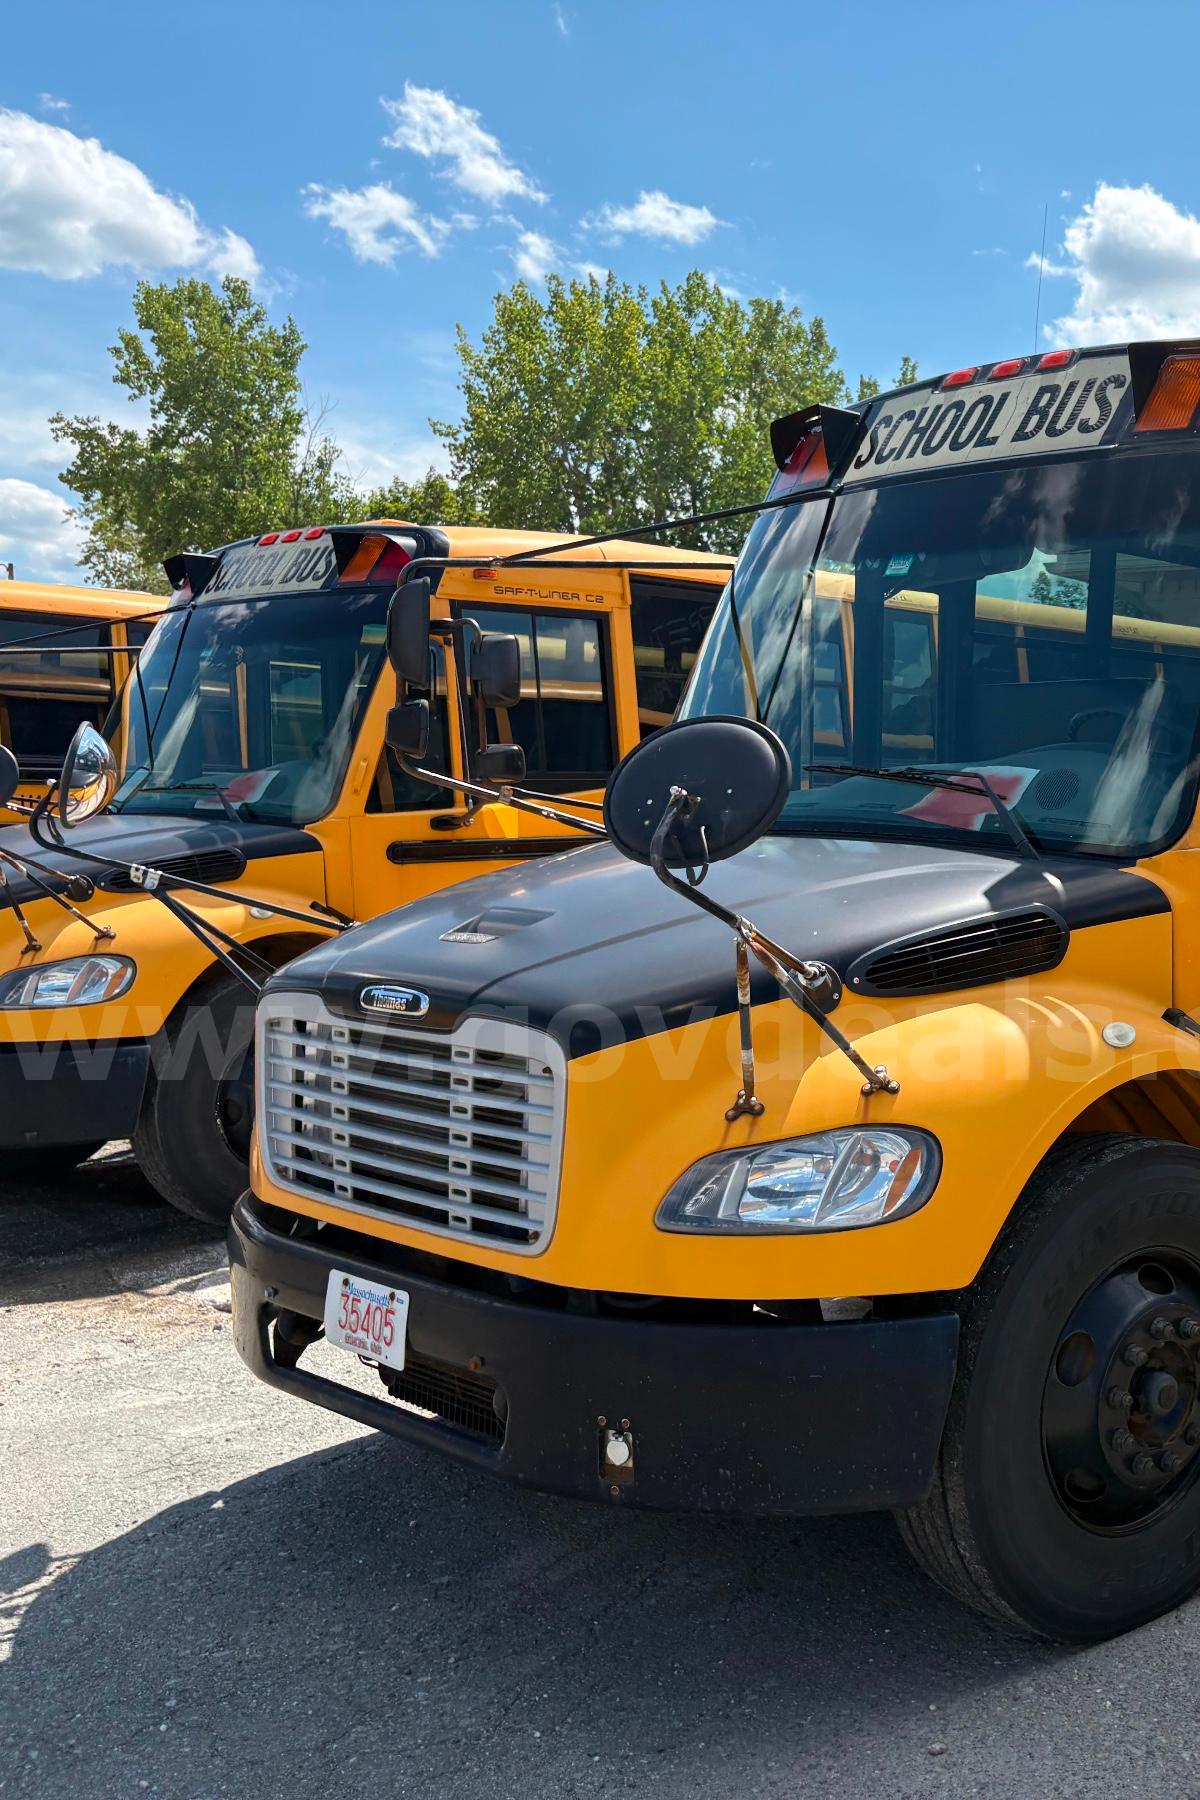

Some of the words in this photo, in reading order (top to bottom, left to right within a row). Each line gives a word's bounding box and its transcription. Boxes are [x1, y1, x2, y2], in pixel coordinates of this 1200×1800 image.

[853, 391, 1011, 470] SCHOOL
[1010, 373, 1127, 443] BUS
[205, 550, 287, 595] SCHOOL
[278, 545, 335, 585] BUS
[585, 593, 604, 604] C2
[371, 989, 414, 1011] Thomas
[338, 1292, 396, 1347] 35405
